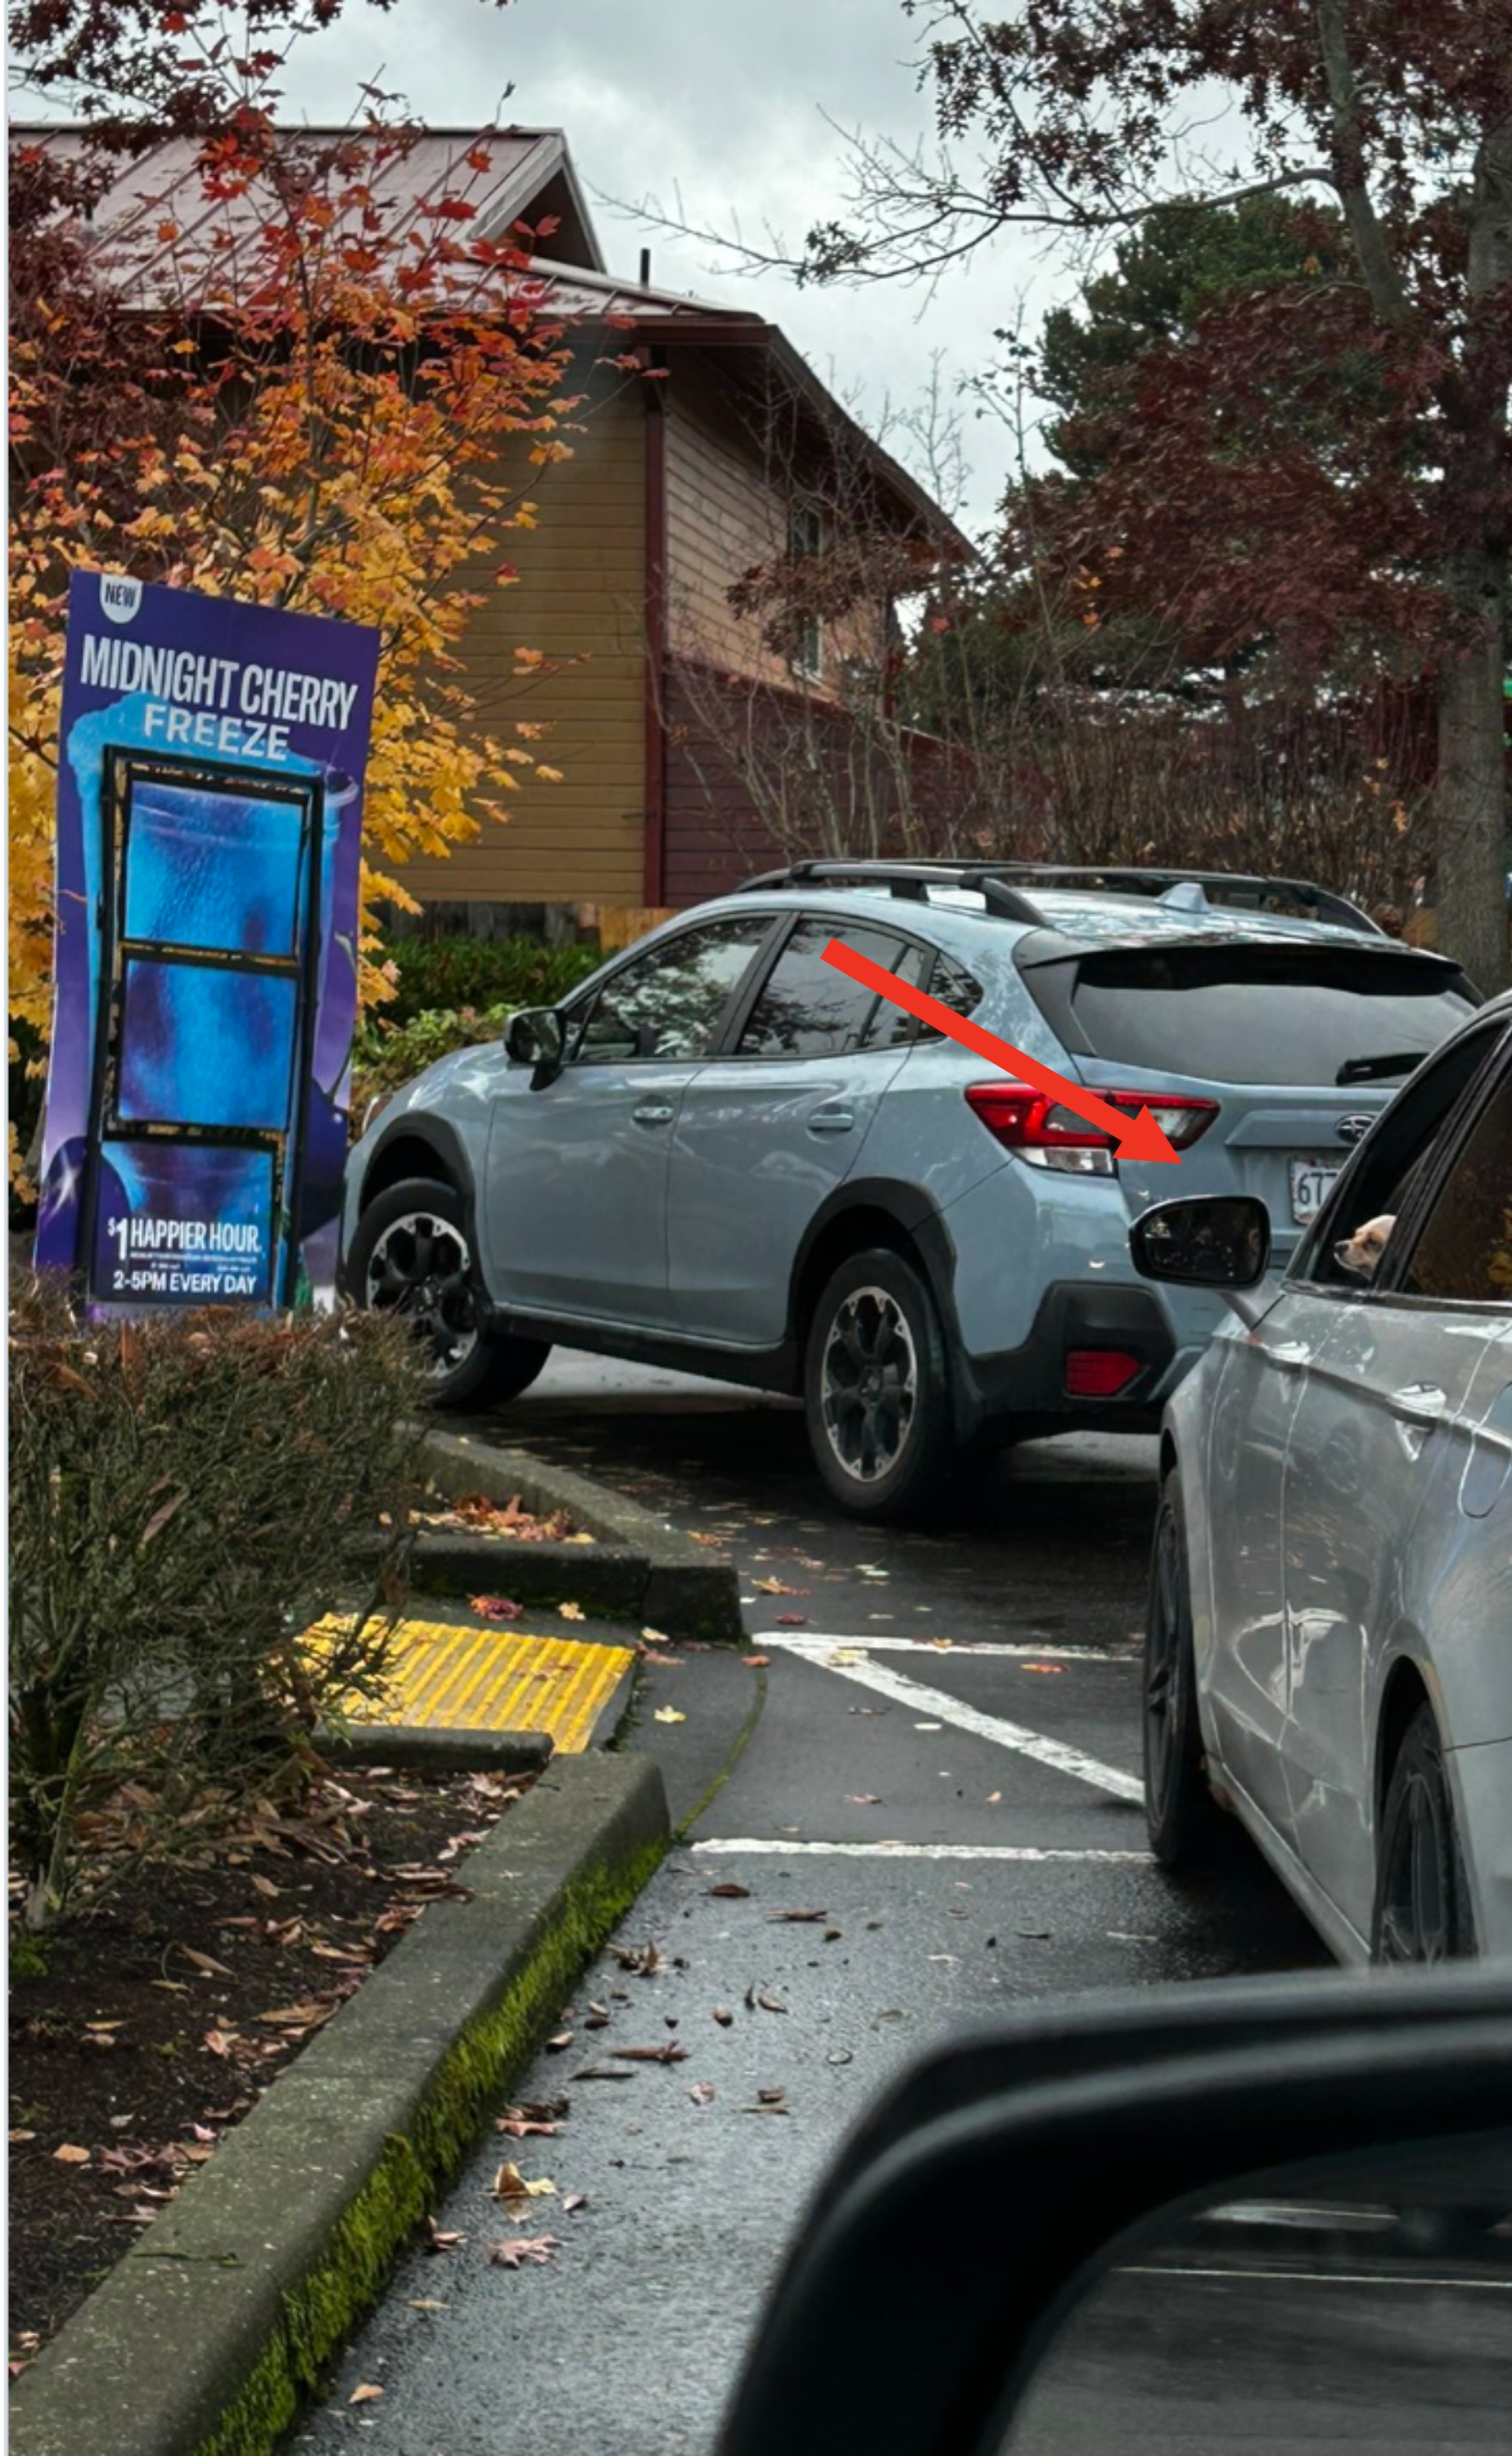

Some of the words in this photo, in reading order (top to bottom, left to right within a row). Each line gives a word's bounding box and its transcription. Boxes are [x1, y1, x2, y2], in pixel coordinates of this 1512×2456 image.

[105, 582, 136, 608] NEW
[81, 634, 239, 709] MIDNIGHT
[240, 665, 359, 730] CHERRY
[144, 702, 290, 761] FREEZE
[107, 1217, 128, 1261] $1
[131, 1217, 206, 1249] HAPPIER
[113, 1270, 167, 1292] 2-5PM
[169, 1272, 223, 1293] EVERY
[223, 1275, 257, 1294] DAY
